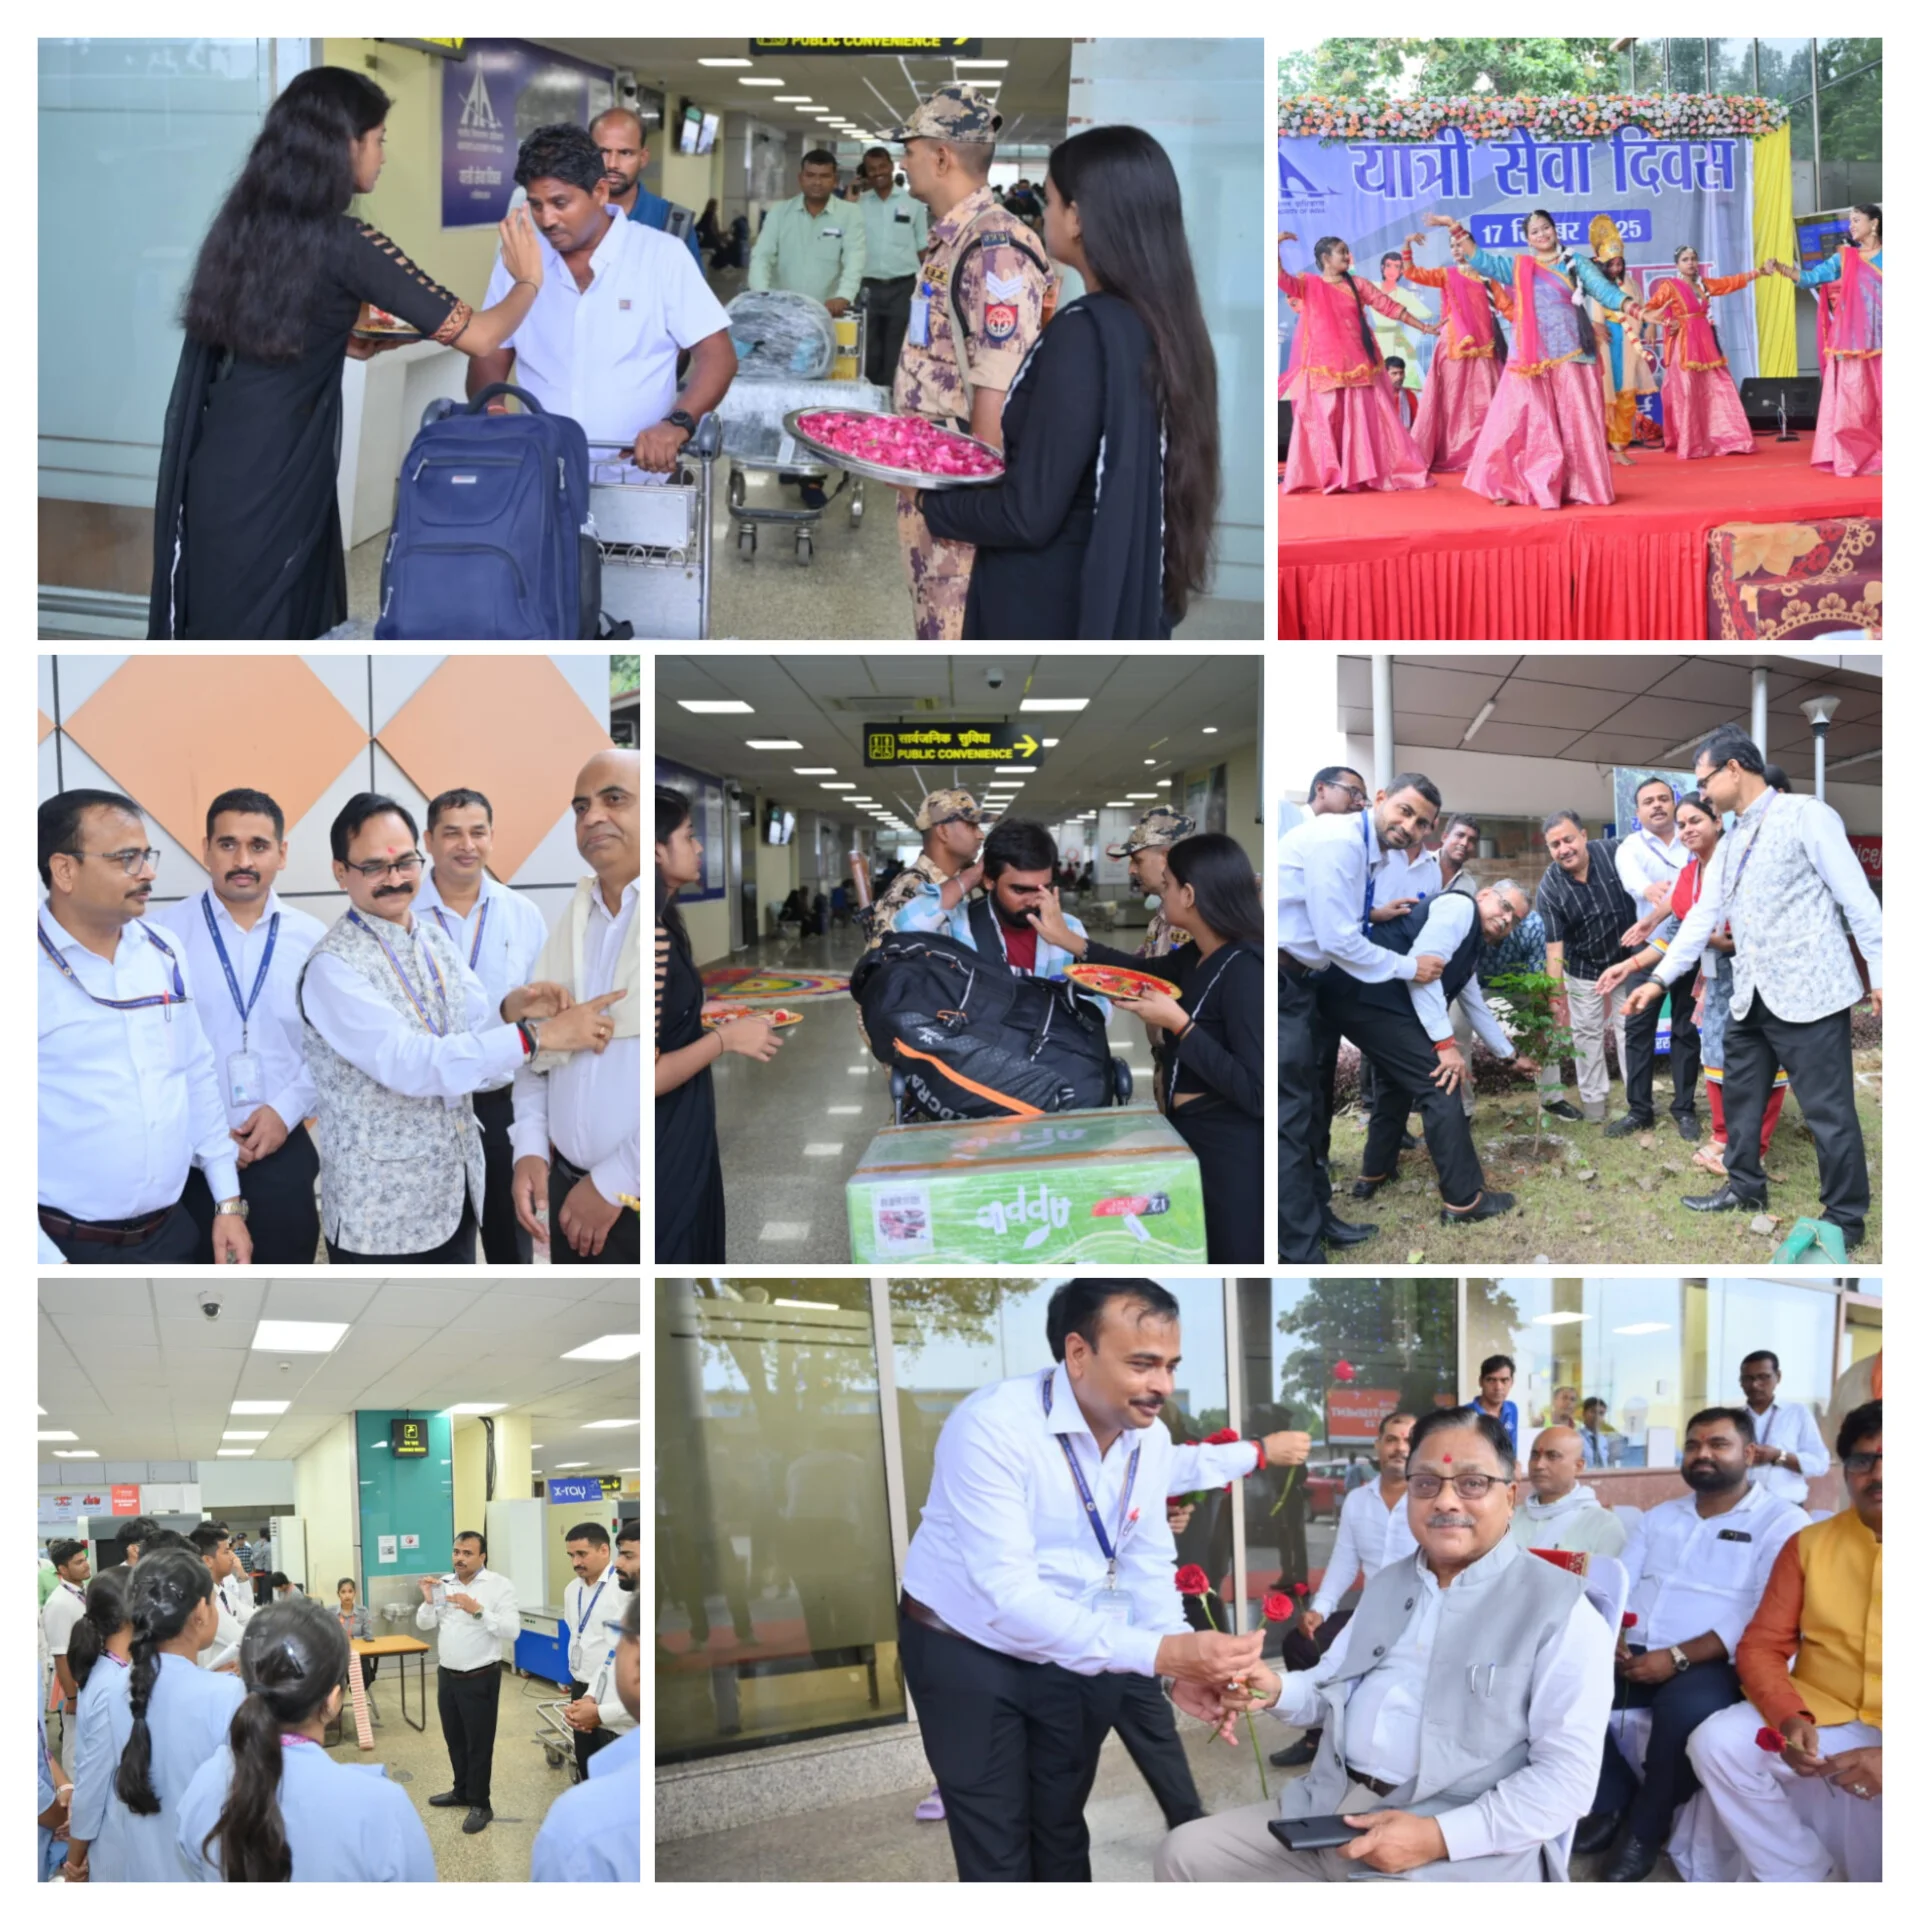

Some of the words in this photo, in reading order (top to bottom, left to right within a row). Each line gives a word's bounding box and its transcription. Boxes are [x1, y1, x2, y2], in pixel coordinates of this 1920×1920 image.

[790, 38, 840, 47] PUBLIC
[843, 38, 942, 47] CONVENIENCE
[1347, 125, 1474, 199] यात्री
[1489, 126, 1593, 197] सेवा
[1609, 124, 1737, 196] दिवस
[1482, 224, 1503, 244] 17
[898, 730, 951, 744] सार्वजनिक
[957, 730, 991, 747] सुविधा
[897, 749, 936, 760] PUBLIC
[938, 748, 1013, 760] CONVENIENCE
[975, 1183, 1072, 1235] Appe
[553, 1486, 586, 1500] x-ray
